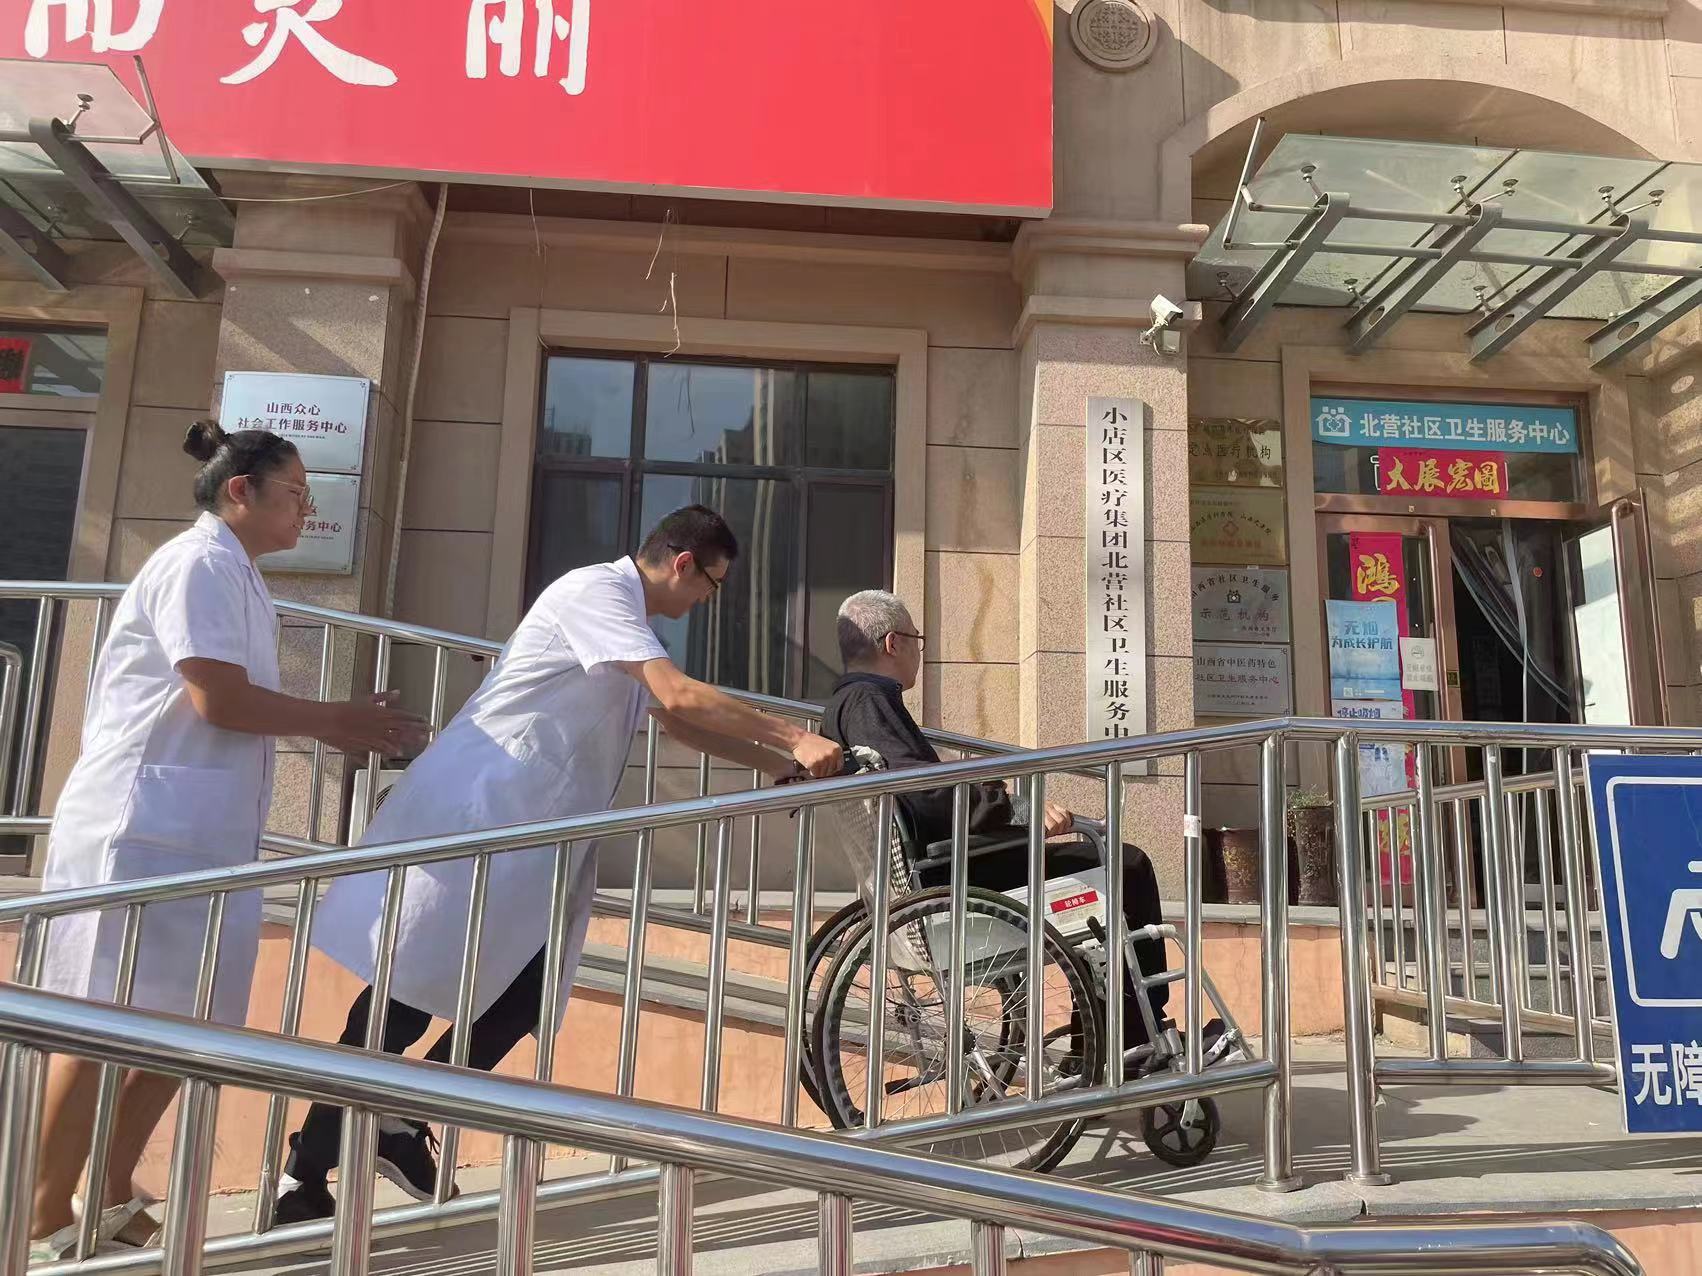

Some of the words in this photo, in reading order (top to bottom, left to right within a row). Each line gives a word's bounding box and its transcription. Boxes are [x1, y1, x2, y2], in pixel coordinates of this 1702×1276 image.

[266, 401, 321, 416] 山西众心
[238, 417, 348, 434] 社会工作服务中心
[1360, 413, 1570, 445] 北营社区卫生服务中心
[1331, 636, 1394, 651] 为成长护航
[1196, 656, 1277, 669] 山西省中医药特色
[1194, 672, 1280, 685] 社区卫生服务中心
[1631, 1040, 1702, 1105] 无障
